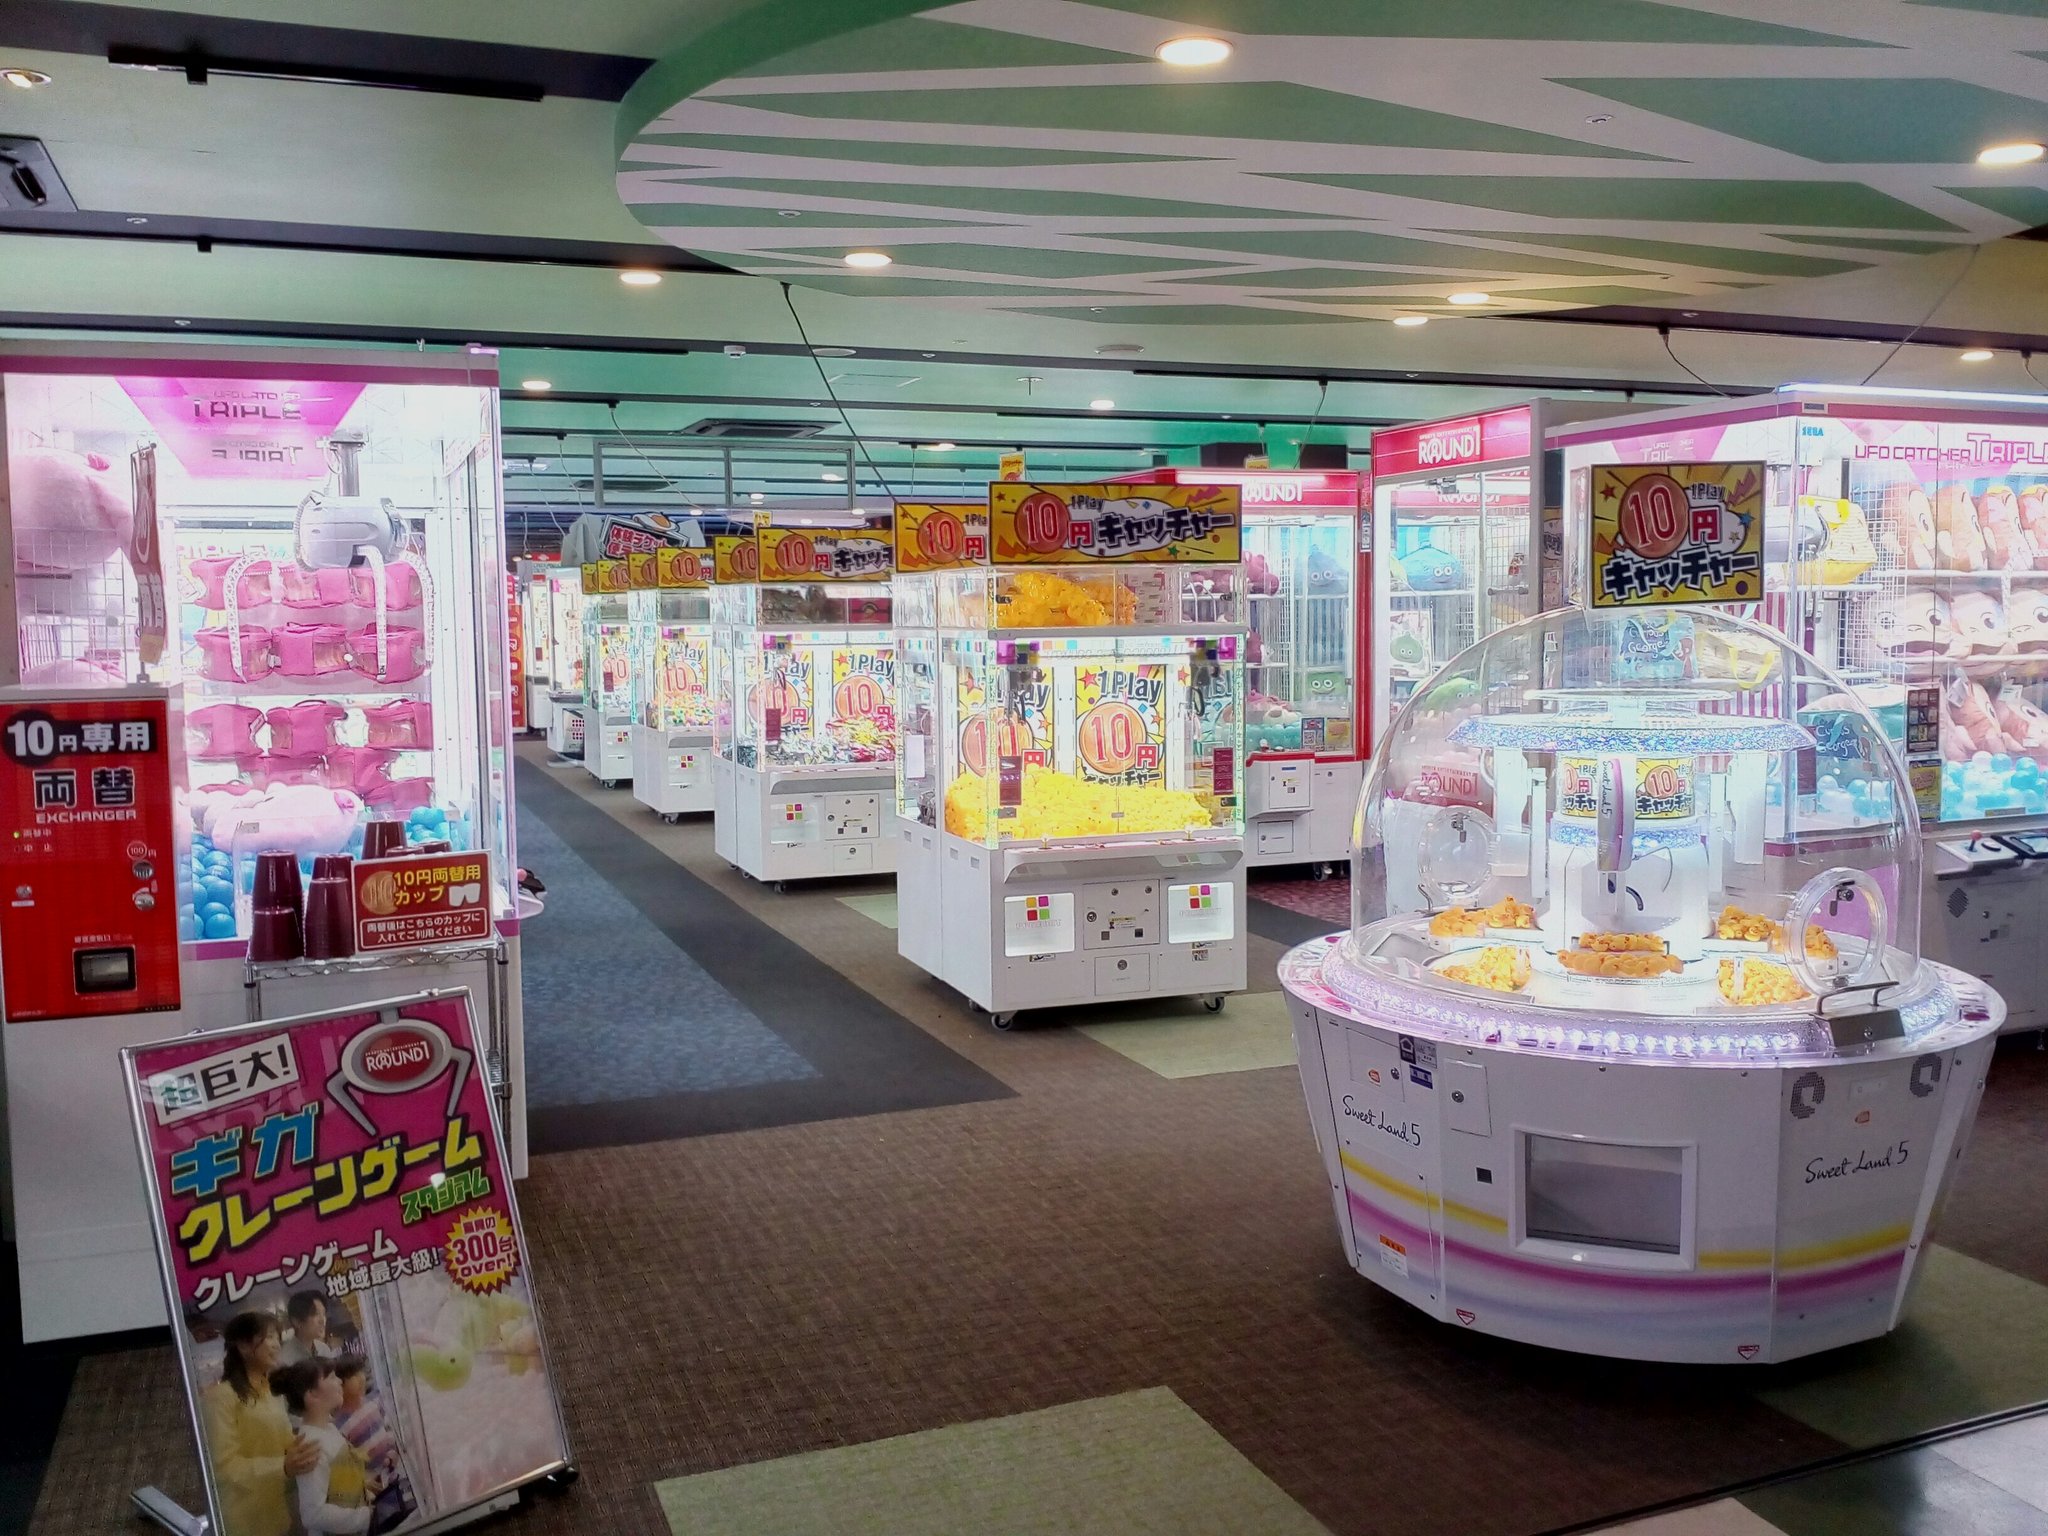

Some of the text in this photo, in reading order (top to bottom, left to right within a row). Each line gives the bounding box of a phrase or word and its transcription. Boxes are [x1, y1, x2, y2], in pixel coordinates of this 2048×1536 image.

[1418, 425, 1480, 464] ROUND1
[1802, 427, 1824, 437] SEGA
[1855, 432, 2048, 464] UFO CATCHER TRIPL
[1243, 480, 1303, 502] OUND1
[1603, 547, 1759, 600] キャッチャー
[7, 720, 150, 757] 10円専用
[33, 766, 135, 810] 両替
[36, 810, 136, 824] EXCHANGER
[393, 865, 480, 886] 10円両替用
[395, 885, 445, 905] カップ
[367, 913, 481, 933] 両替後はこちらのカップに
[377, 925, 472, 944] 入れてご利用ください
[365, 1041, 430, 1072] ROUND1
[1342, 1094, 1421, 1146] Sweet Land 5
[171, 1101, 319, 1198] ギガ
[1805, 1140, 1910, 1184] Sweet Land 5
[180, 1118, 482, 1263] クレーンゲーム
[400, 1166, 491, 1225] スタジアム
[194, 1229, 399, 1311] クレーンゲーム
